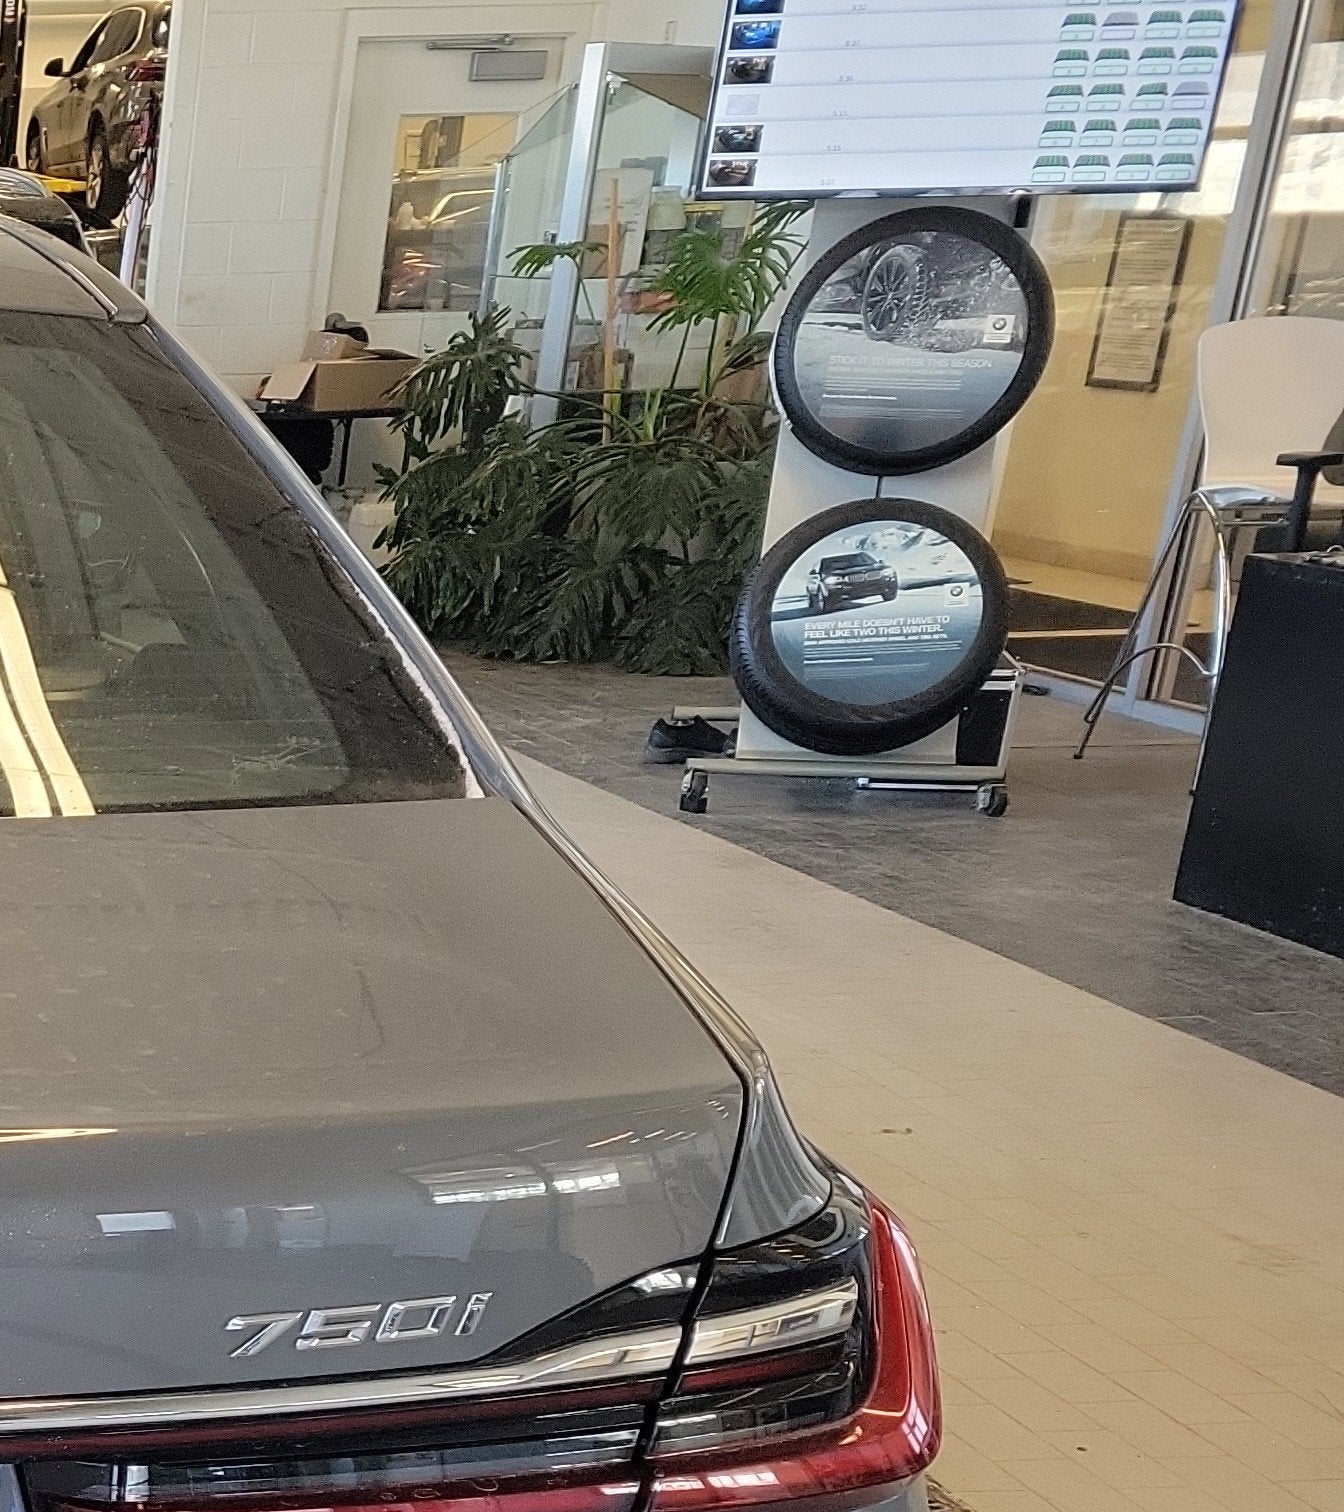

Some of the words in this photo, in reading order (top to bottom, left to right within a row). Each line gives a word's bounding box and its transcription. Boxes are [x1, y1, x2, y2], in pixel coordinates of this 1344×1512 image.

[804, 621, 836, 631] EVERY
[838, 620, 861, 629] MILE
[907, 616, 935, 625] HAVE
[937, 615, 950, 623] TO
[804, 629, 828, 639] FEEL
[830, 628, 852, 637] LIKE
[854, 627, 876, 637] TWO
[879, 626, 901, 635] THIS
[225, 1291, 493, 1358] 750i
